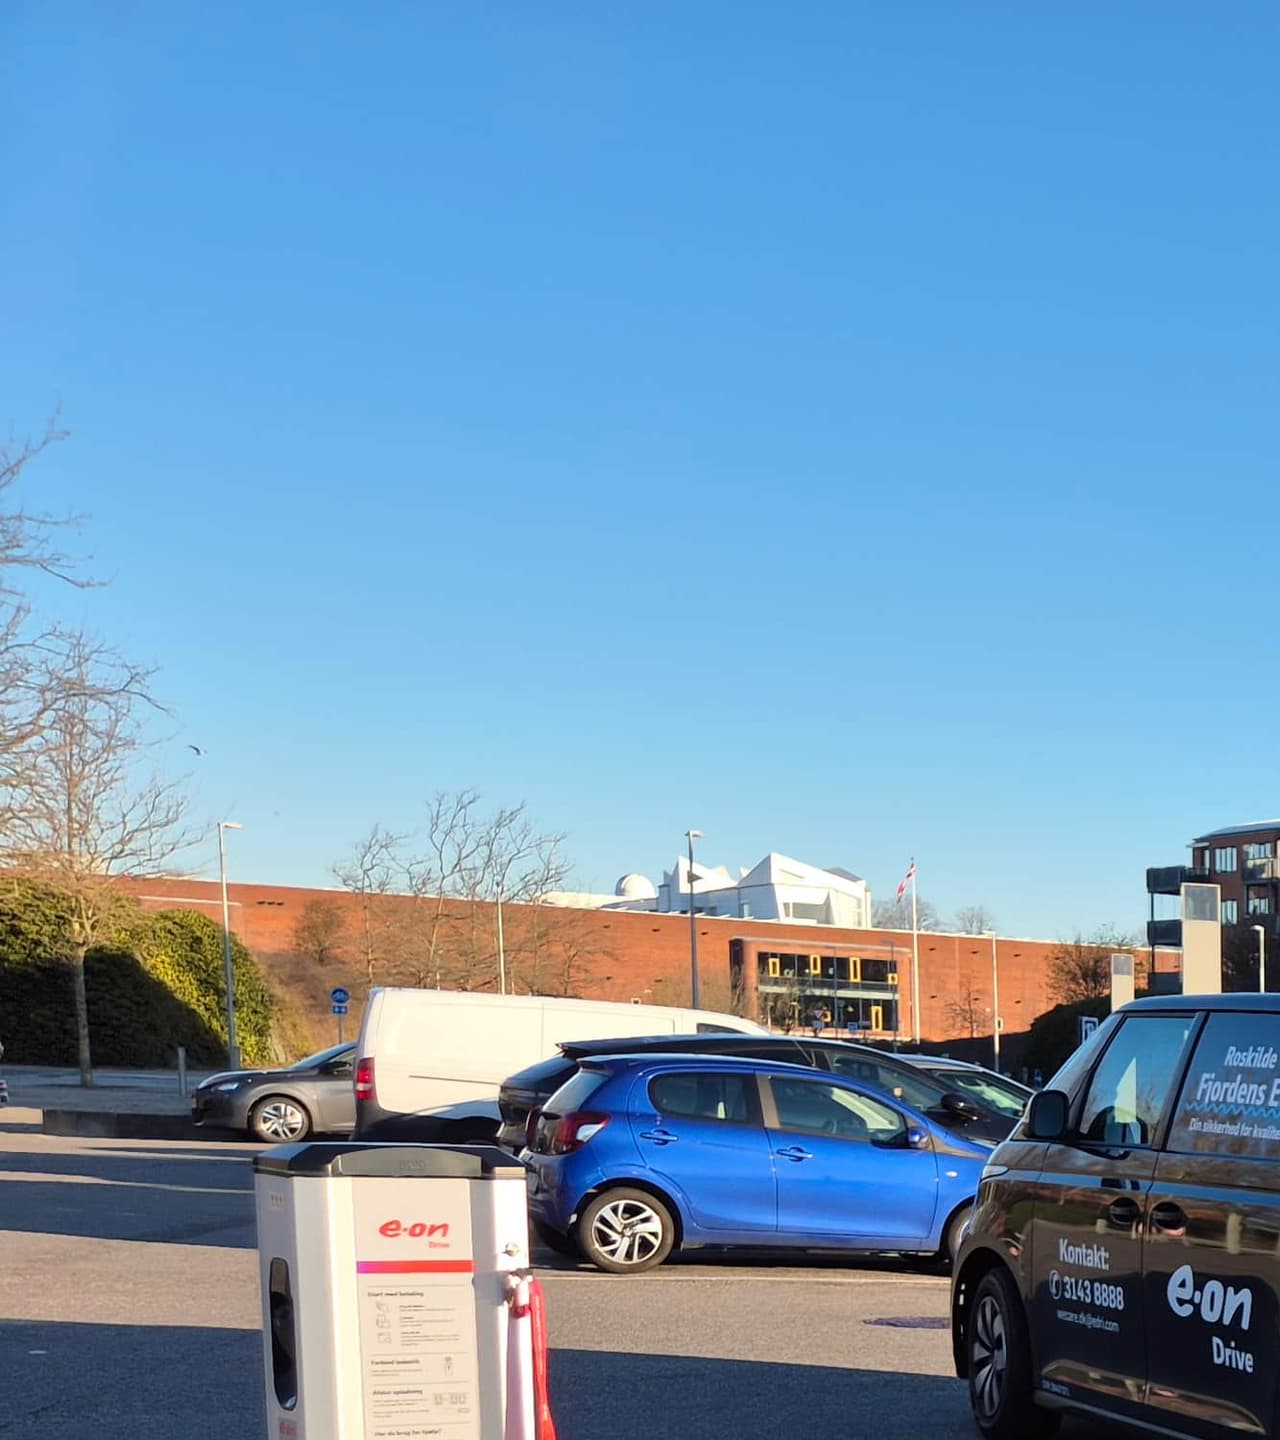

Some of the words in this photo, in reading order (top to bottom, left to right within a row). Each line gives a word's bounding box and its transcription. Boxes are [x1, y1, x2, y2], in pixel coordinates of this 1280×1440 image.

[1224, 1046, 1279, 1069] Roskilde
[1196, 1072, 1268, 1105] Fjordens
[1202, 1119, 1240, 1136] sikkerhed
[1240, 1122, 1252, 1137] for
[1059, 1238, 1110, 1271] Kontakt:
[1063, 1275, 1092, 1304] 3143
[1093, 1281, 1125, 1311] 8888
[1211, 1335, 1254, 1374] Drive
